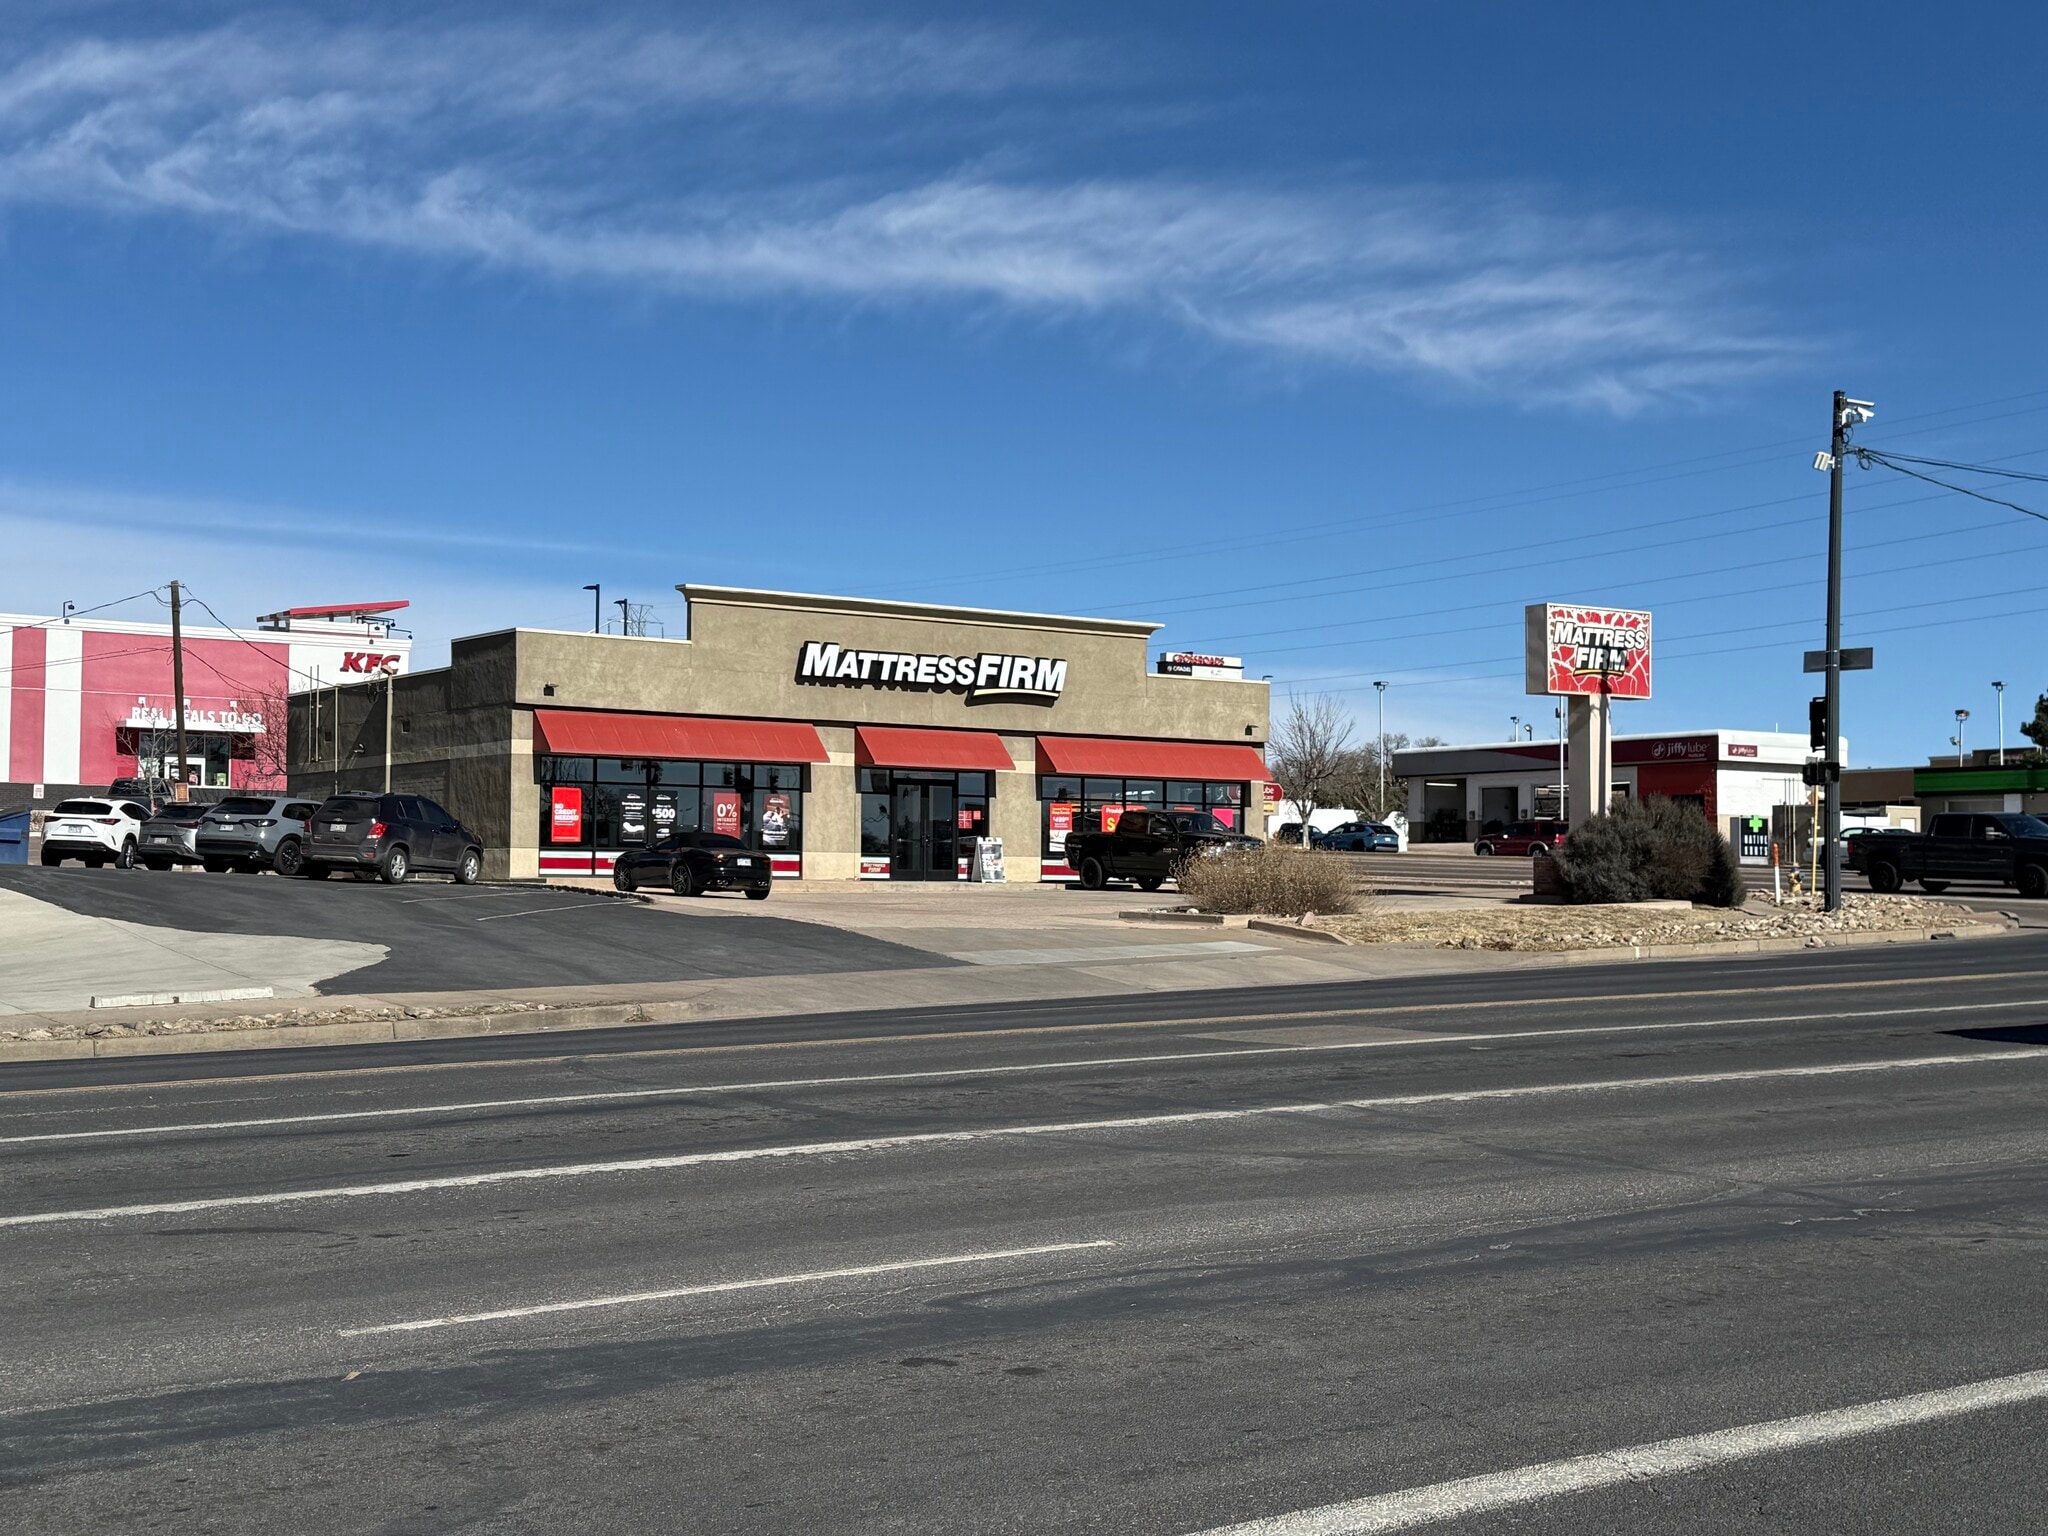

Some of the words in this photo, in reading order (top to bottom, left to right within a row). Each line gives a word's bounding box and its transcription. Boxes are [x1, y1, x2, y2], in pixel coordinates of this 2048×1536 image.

[1553, 621, 1647, 649] MATTRESS
[340, 651, 401, 675] KFC
[1172, 653, 1225, 666] CROSSROADS
[1575, 646, 1628, 671] FIRM
[131, 706, 168, 720] REAL
[220, 711, 236, 724] TO
[1666, 742, 1687, 757] jiffy
[1687, 741, 1707, 753] lube
[652, 808, 676, 818] $500
[716, 803, 738, 817] 0%
